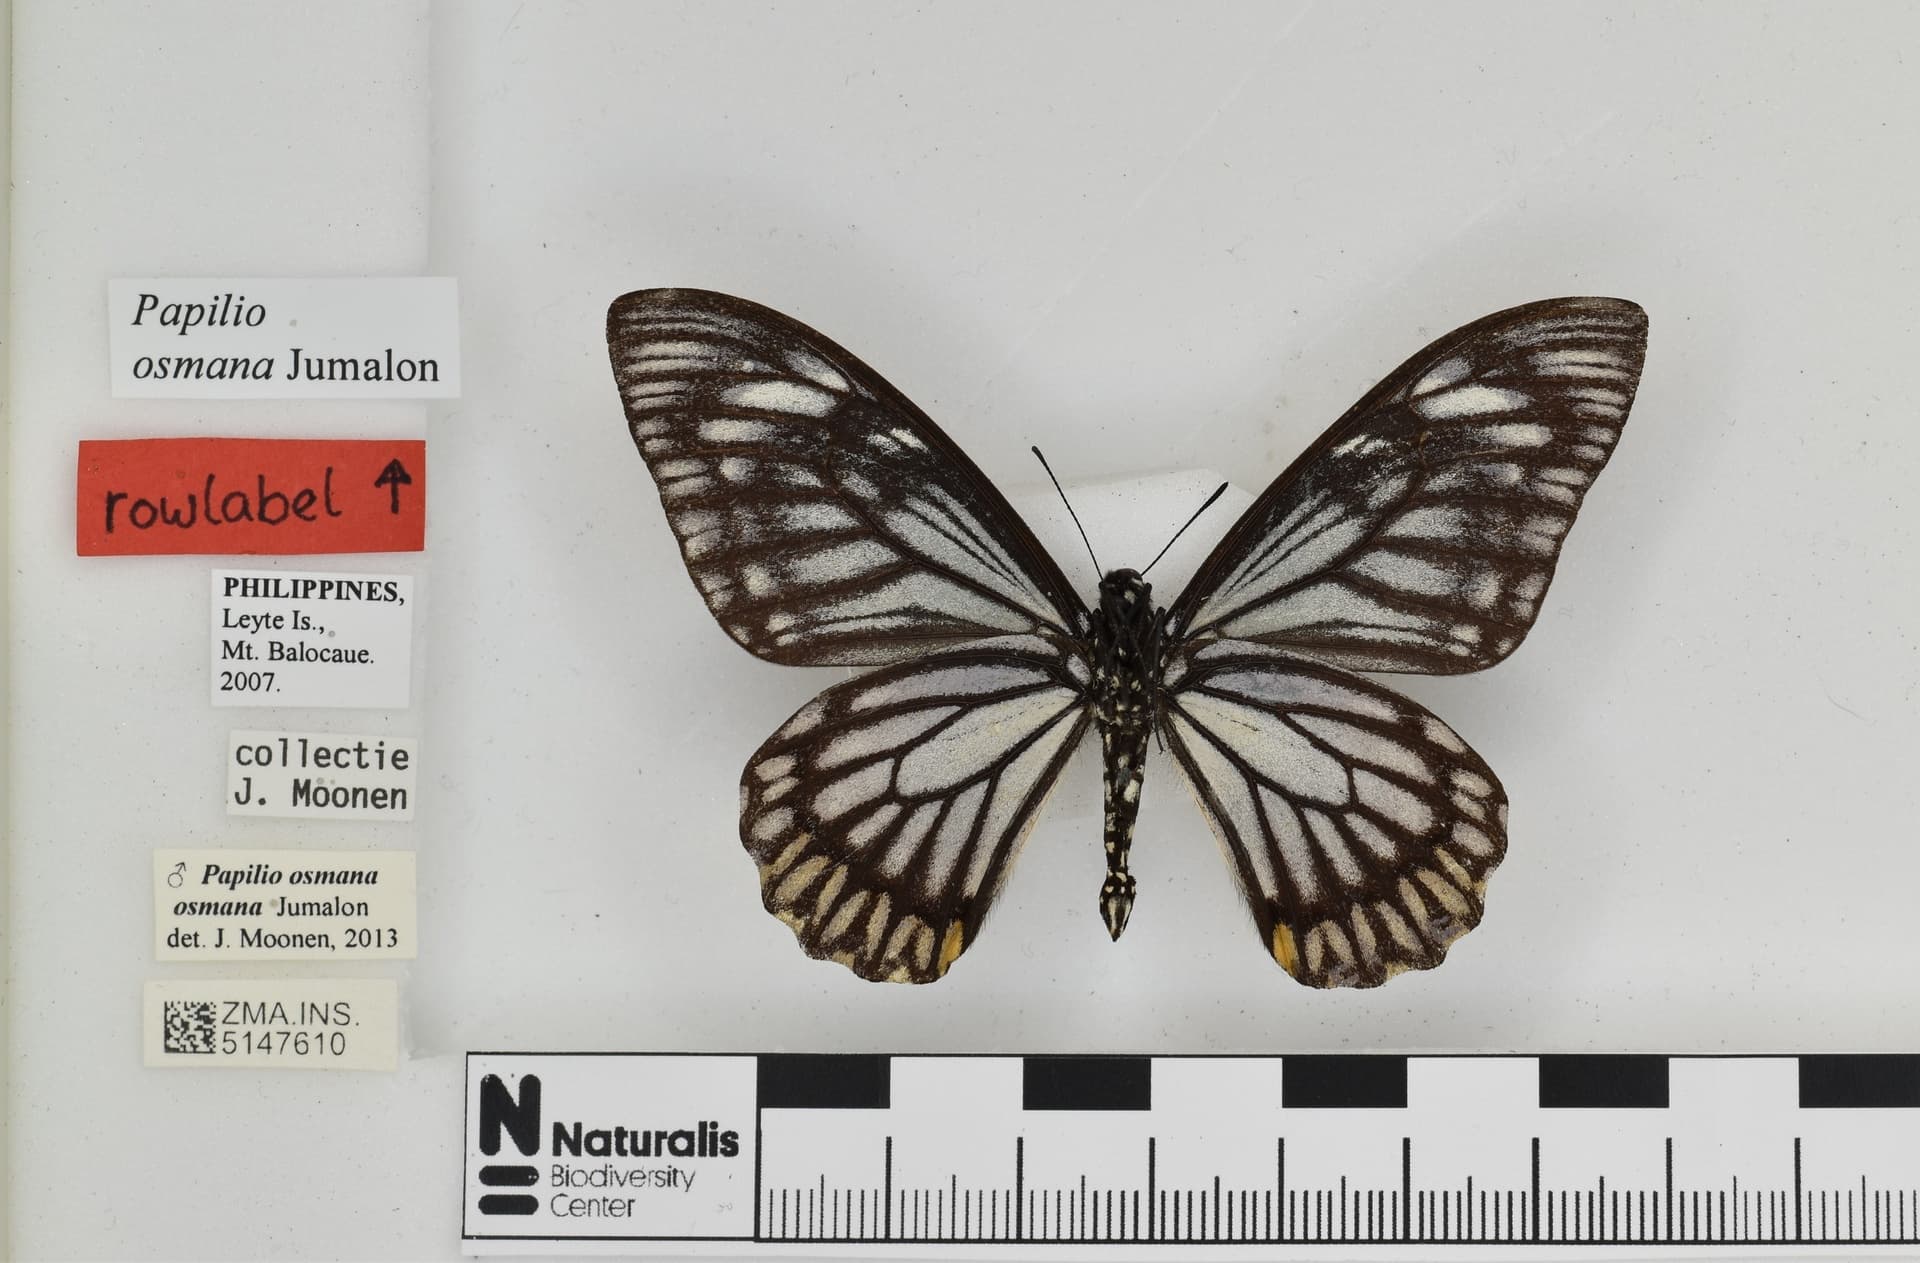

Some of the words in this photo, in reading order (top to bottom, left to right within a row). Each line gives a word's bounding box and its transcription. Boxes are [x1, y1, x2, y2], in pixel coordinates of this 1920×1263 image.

[131, 293, 266, 336] Papilio
[132, 355, 275, 380] osmana
[287, 348, 440, 382] Jumalon
[104, 467, 342, 533] rowlabel
[223, 576, 405, 606] PHILIPPINES,
[222, 608, 285, 634] Leyte
[292, 610, 325, 634] Is.,
[221, 640, 259, 661] Mt.
[268, 641, 375, 664] Balocaue.
[220, 671, 281, 692] 2007.
[235, 738, 409, 771] collectie
[234, 777, 267, 806] J.
[292, 778, 408, 810] Moonen
[201, 864, 283, 890] Papilio
[289, 867, 379, 885] osmana
[173, 900, 263, 916] osmana
[276, 896, 369, 917] Jumalon
[166, 928, 206, 948] det.
[215, 928, 231, 948] J.
[240, 928, 336, 951] Moonen,
[344, 928, 399, 948] 2013
[221, 1001, 360, 1026] ZMA.INS.
[222, 1031, 346, 1056] 5147610
[552, 1120, 740, 1158] Naturalis
[550, 1163, 696, 1192] Biodiversity
[550, 1193, 636, 1218] Center
